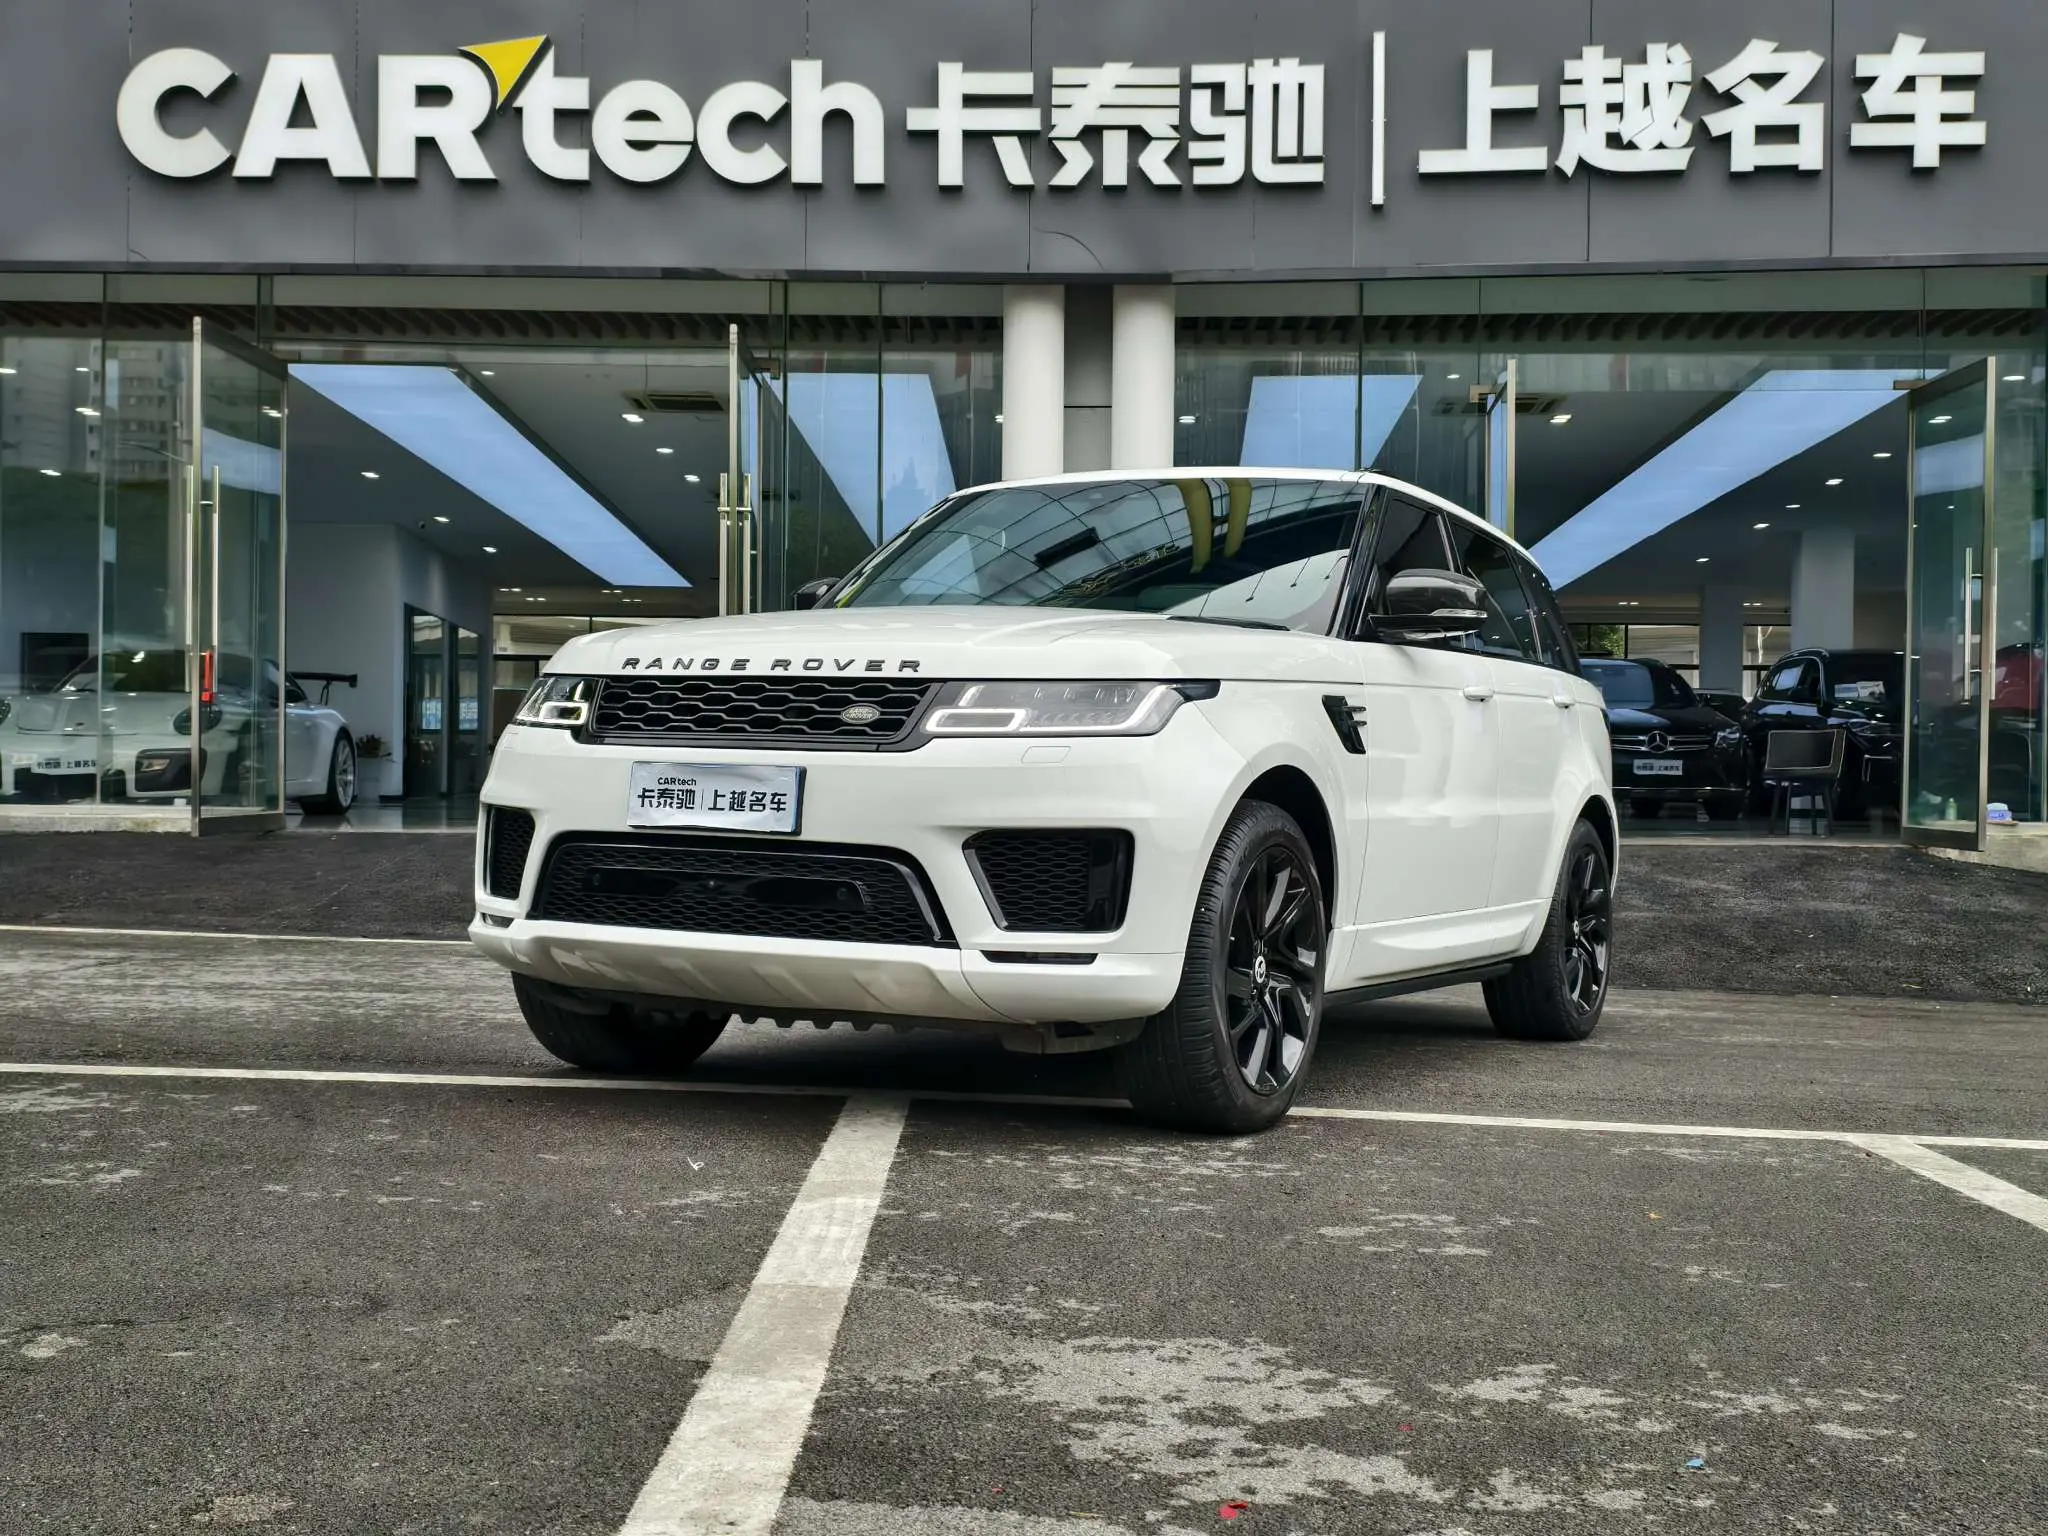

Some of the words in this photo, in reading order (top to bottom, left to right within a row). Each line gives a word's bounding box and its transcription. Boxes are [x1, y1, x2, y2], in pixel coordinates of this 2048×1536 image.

[117, 45, 884, 184] CARtech
[906, 58, 1326, 188] 卡泰驰
[1417, 34, 1987, 177] 上越名车
[621, 657, 751, 671] RANGE
[770, 658, 920, 673] ROVER
[657, 777, 697, 786] CARtech
[637, 788, 696, 810] 卡泰驰
[707, 789, 788, 813] 上越名车
